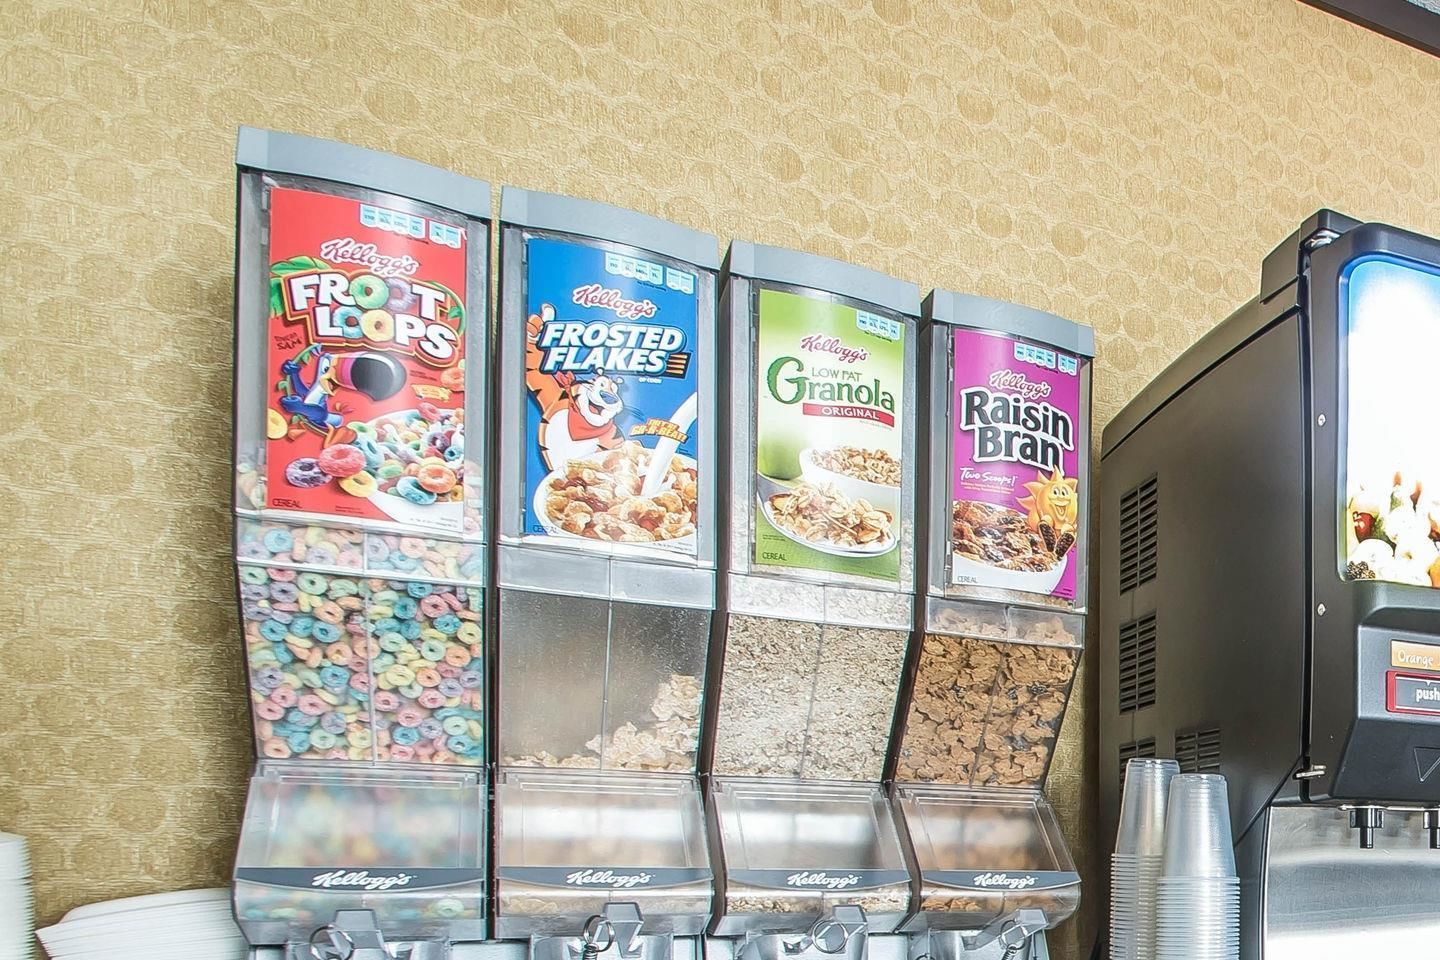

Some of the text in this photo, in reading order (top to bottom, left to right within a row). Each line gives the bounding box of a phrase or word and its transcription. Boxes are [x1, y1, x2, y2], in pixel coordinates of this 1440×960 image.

[321, 238, 419, 275] Kellogg's
[289, 273, 446, 321] FROOT
[573, 285, 657, 319] Kellogg's
[313, 305, 458, 359] LOOPS
[540, 322, 684, 352] FROSTED
[800, 334, 868, 363] Kellogg's
[541, 347, 668, 375] FLAKES
[811, 367, 862, 382] LOW FAT
[990, 370, 1051, 399] Kellogg's
[766, 356, 896, 415] Granola
[821, 406, 880, 421] ORIGINAL
[963, 390, 1073, 447] Raisin
[976, 426, 1061, 469] Bran
[959, 467, 981, 481] Two
[272, 498, 303, 508] CEREAL
[762, 552, 788, 561] CEREAL
[957, 576, 979, 584] CEREAL
[1397, 650, 1434, 669] Orange
[1415, 687, 1440, 702] push
[312, 869, 412, 890] Kellogg's
[566, 869, 652, 889] Kellogg's
[786, 871, 859, 888] Kellogg's
[973, 872, 1036, 888] Kellogg's
